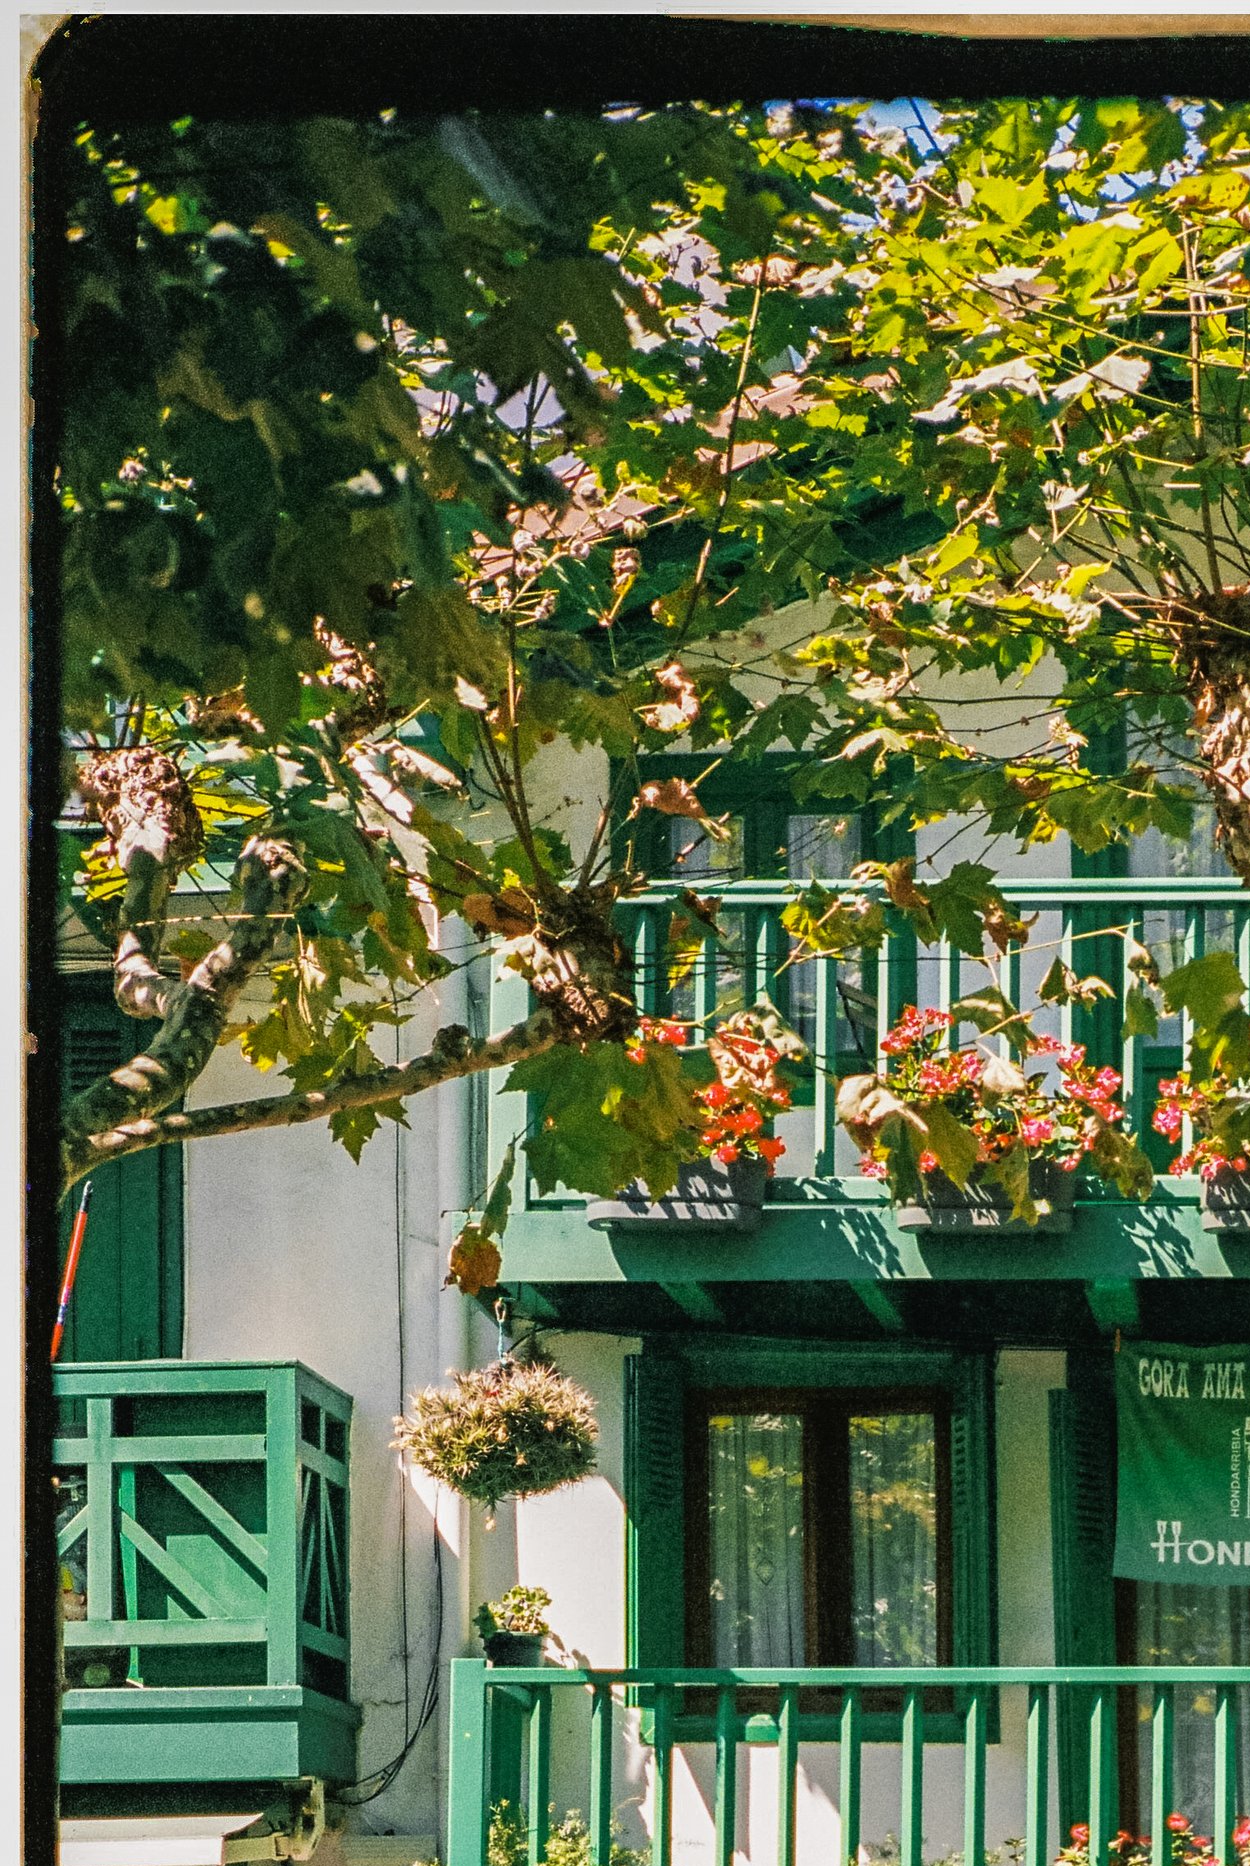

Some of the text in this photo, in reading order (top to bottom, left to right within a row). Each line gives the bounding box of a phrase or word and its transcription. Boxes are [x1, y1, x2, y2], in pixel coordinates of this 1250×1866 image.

[1138, 1357, 1190, 1399] GORA
[1202, 1362, 1246, 1400] AMA
[1230, 1428, 1241, 1518] HONDARRIBIA
